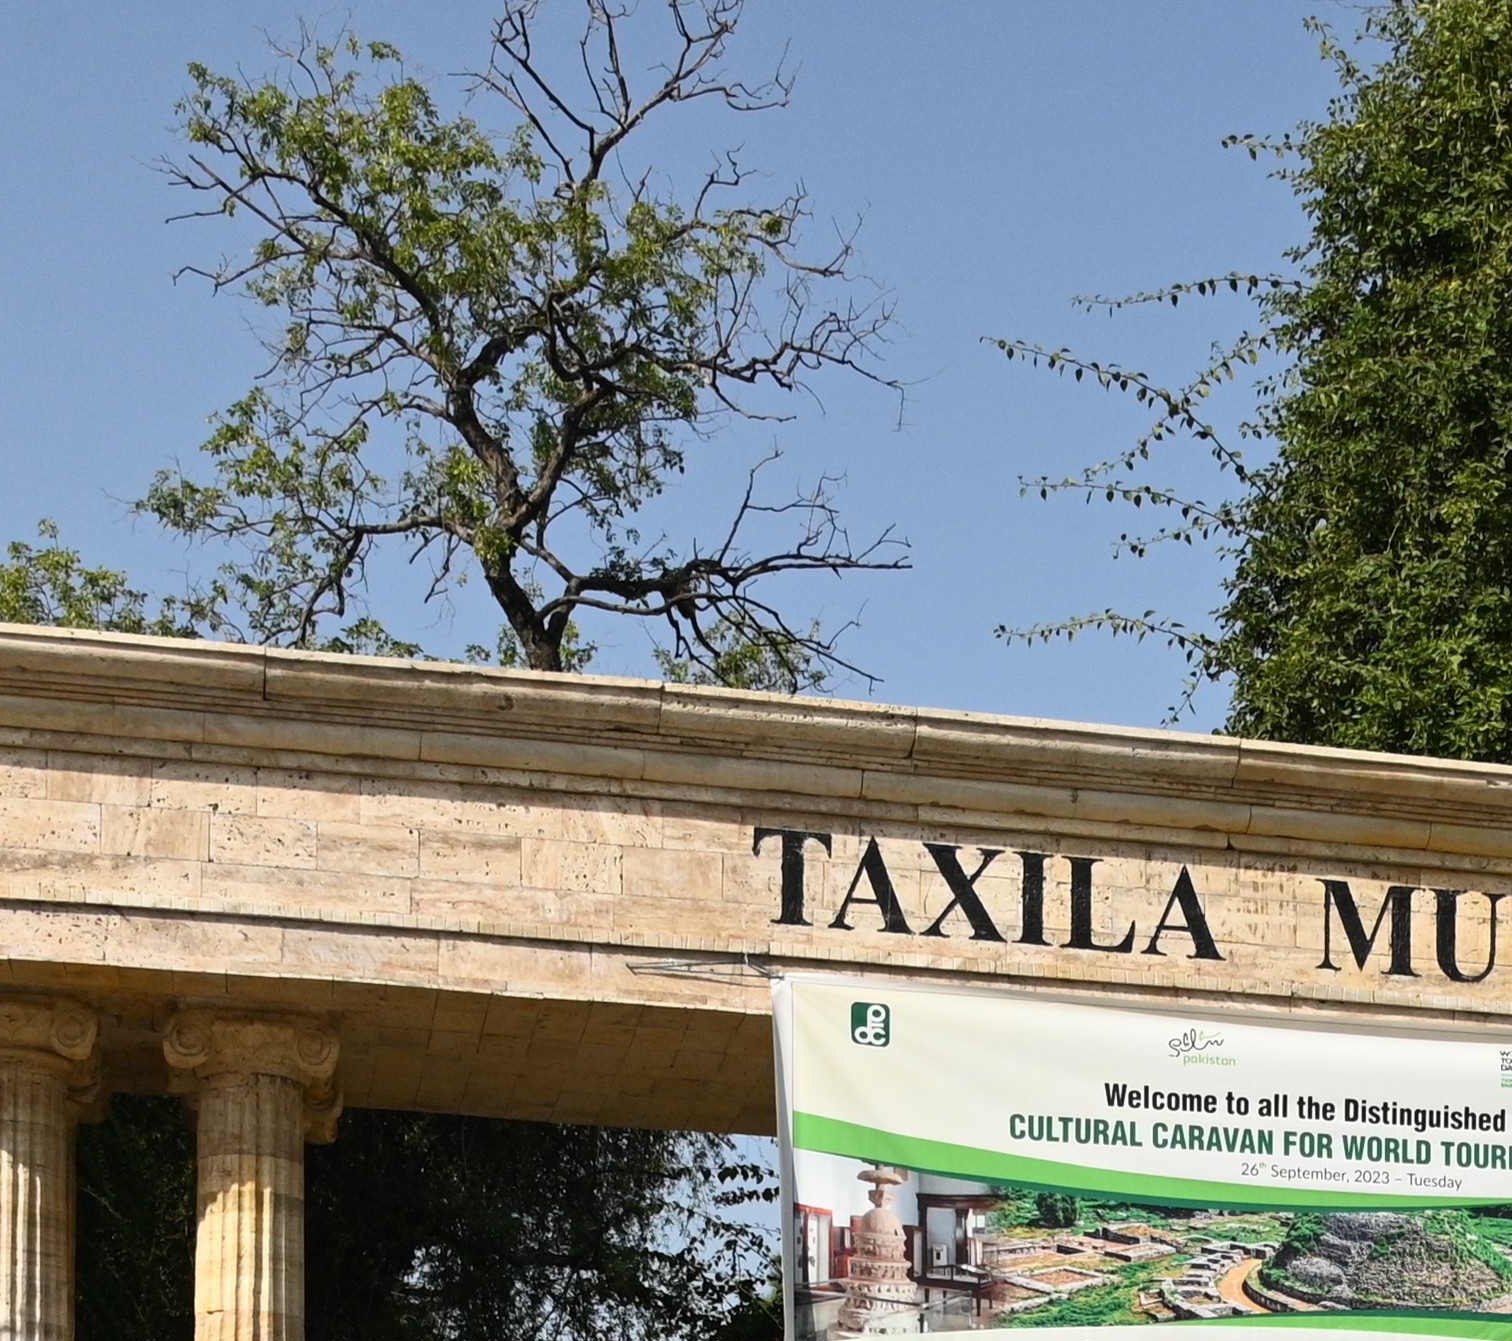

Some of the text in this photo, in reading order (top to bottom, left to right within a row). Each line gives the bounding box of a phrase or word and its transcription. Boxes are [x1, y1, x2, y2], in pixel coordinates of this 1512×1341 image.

[753, 827, 1227, 962] TAXILA
[1183, 1054, 1236, 1066] pakistan
[1105, 1083, 1217, 1113] Welcome
[1226, 1091, 1249, 1116] to
[1258, 1094, 1287, 1118] all
[1297, 1096, 1335, 1121] the
[1344, 1098, 1506, 1132] Distinguished
[1009, 1114, 1143, 1147] CULTURAL
[1152, 1122, 1273, 1155] CARAVAN
[1284, 1131, 1333, 1159] FOR
[1343, 1135, 1431, 1165] WORLD
[1270, 1164, 1350, 1183] September,
[1354, 1170, 1390, 1184] 2023
[1407, 1173, 1462, 1191] Tuesday
